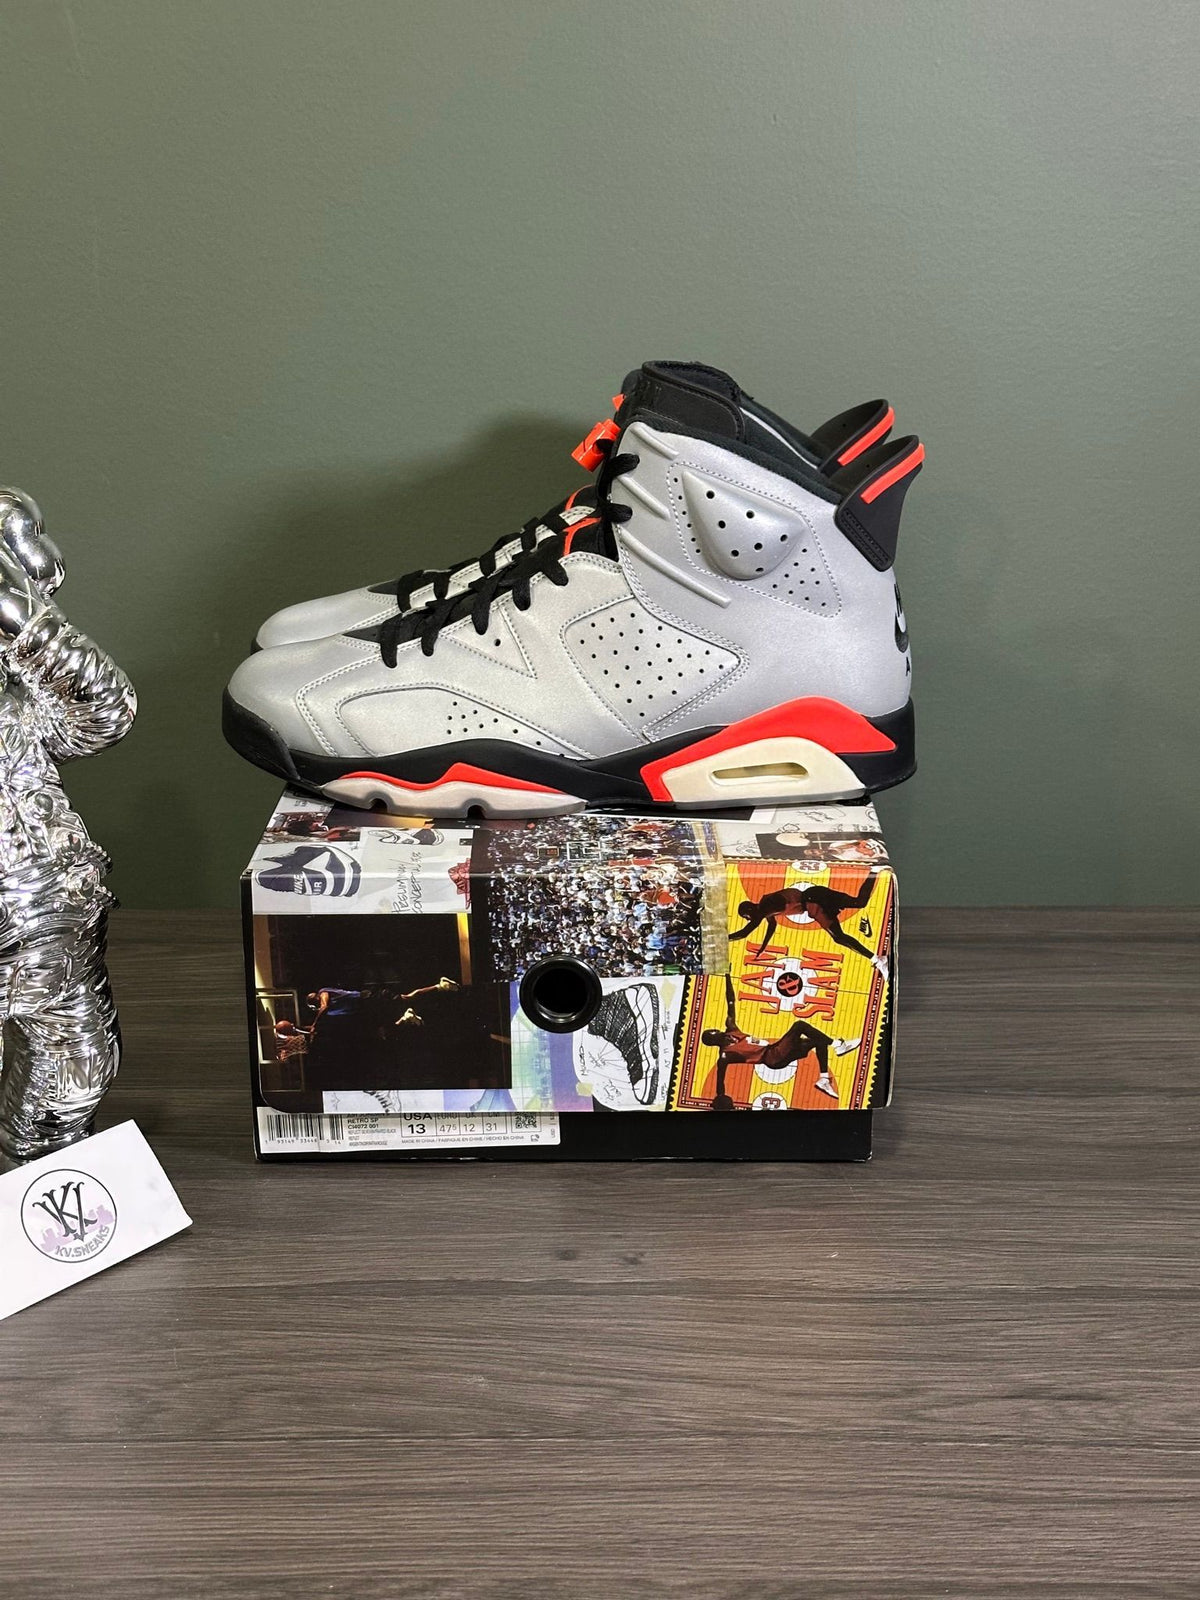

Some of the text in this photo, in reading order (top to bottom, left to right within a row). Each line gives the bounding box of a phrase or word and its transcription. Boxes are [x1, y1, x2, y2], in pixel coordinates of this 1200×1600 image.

[738, 941, 789, 1014] JAM
[792, 948, 844, 1021] SLAM
[403, 1112, 433, 1120] USA
[408, 1123, 426, 1134] 13
[463, 1123, 476, 1132] 12
[485, 1122, 497, 1132] 31
[55, 1224, 110, 1259] KV.SNEAKS
